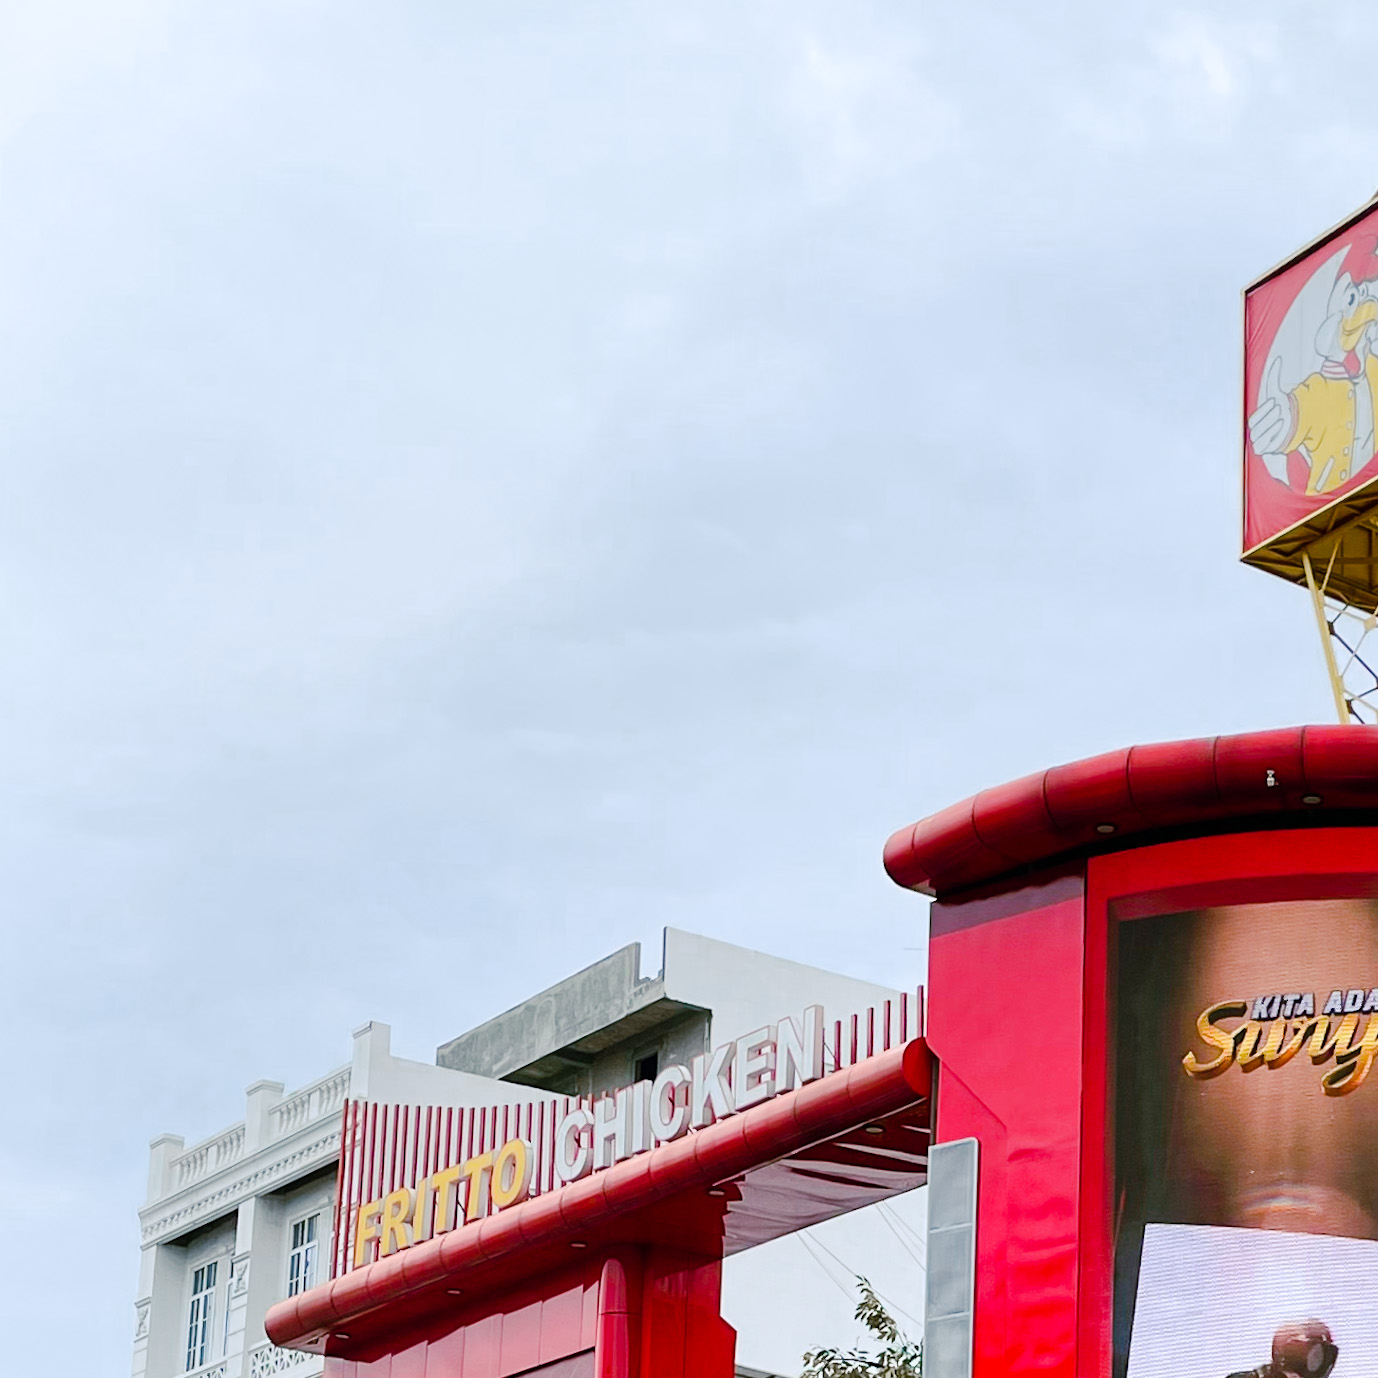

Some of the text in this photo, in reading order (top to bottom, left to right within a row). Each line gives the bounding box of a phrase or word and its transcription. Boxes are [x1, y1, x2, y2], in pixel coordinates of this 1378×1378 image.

[1251, 992, 1315, 1021] KITA
[354, 1004, 824, 1268] FRITTO CHICKEN
